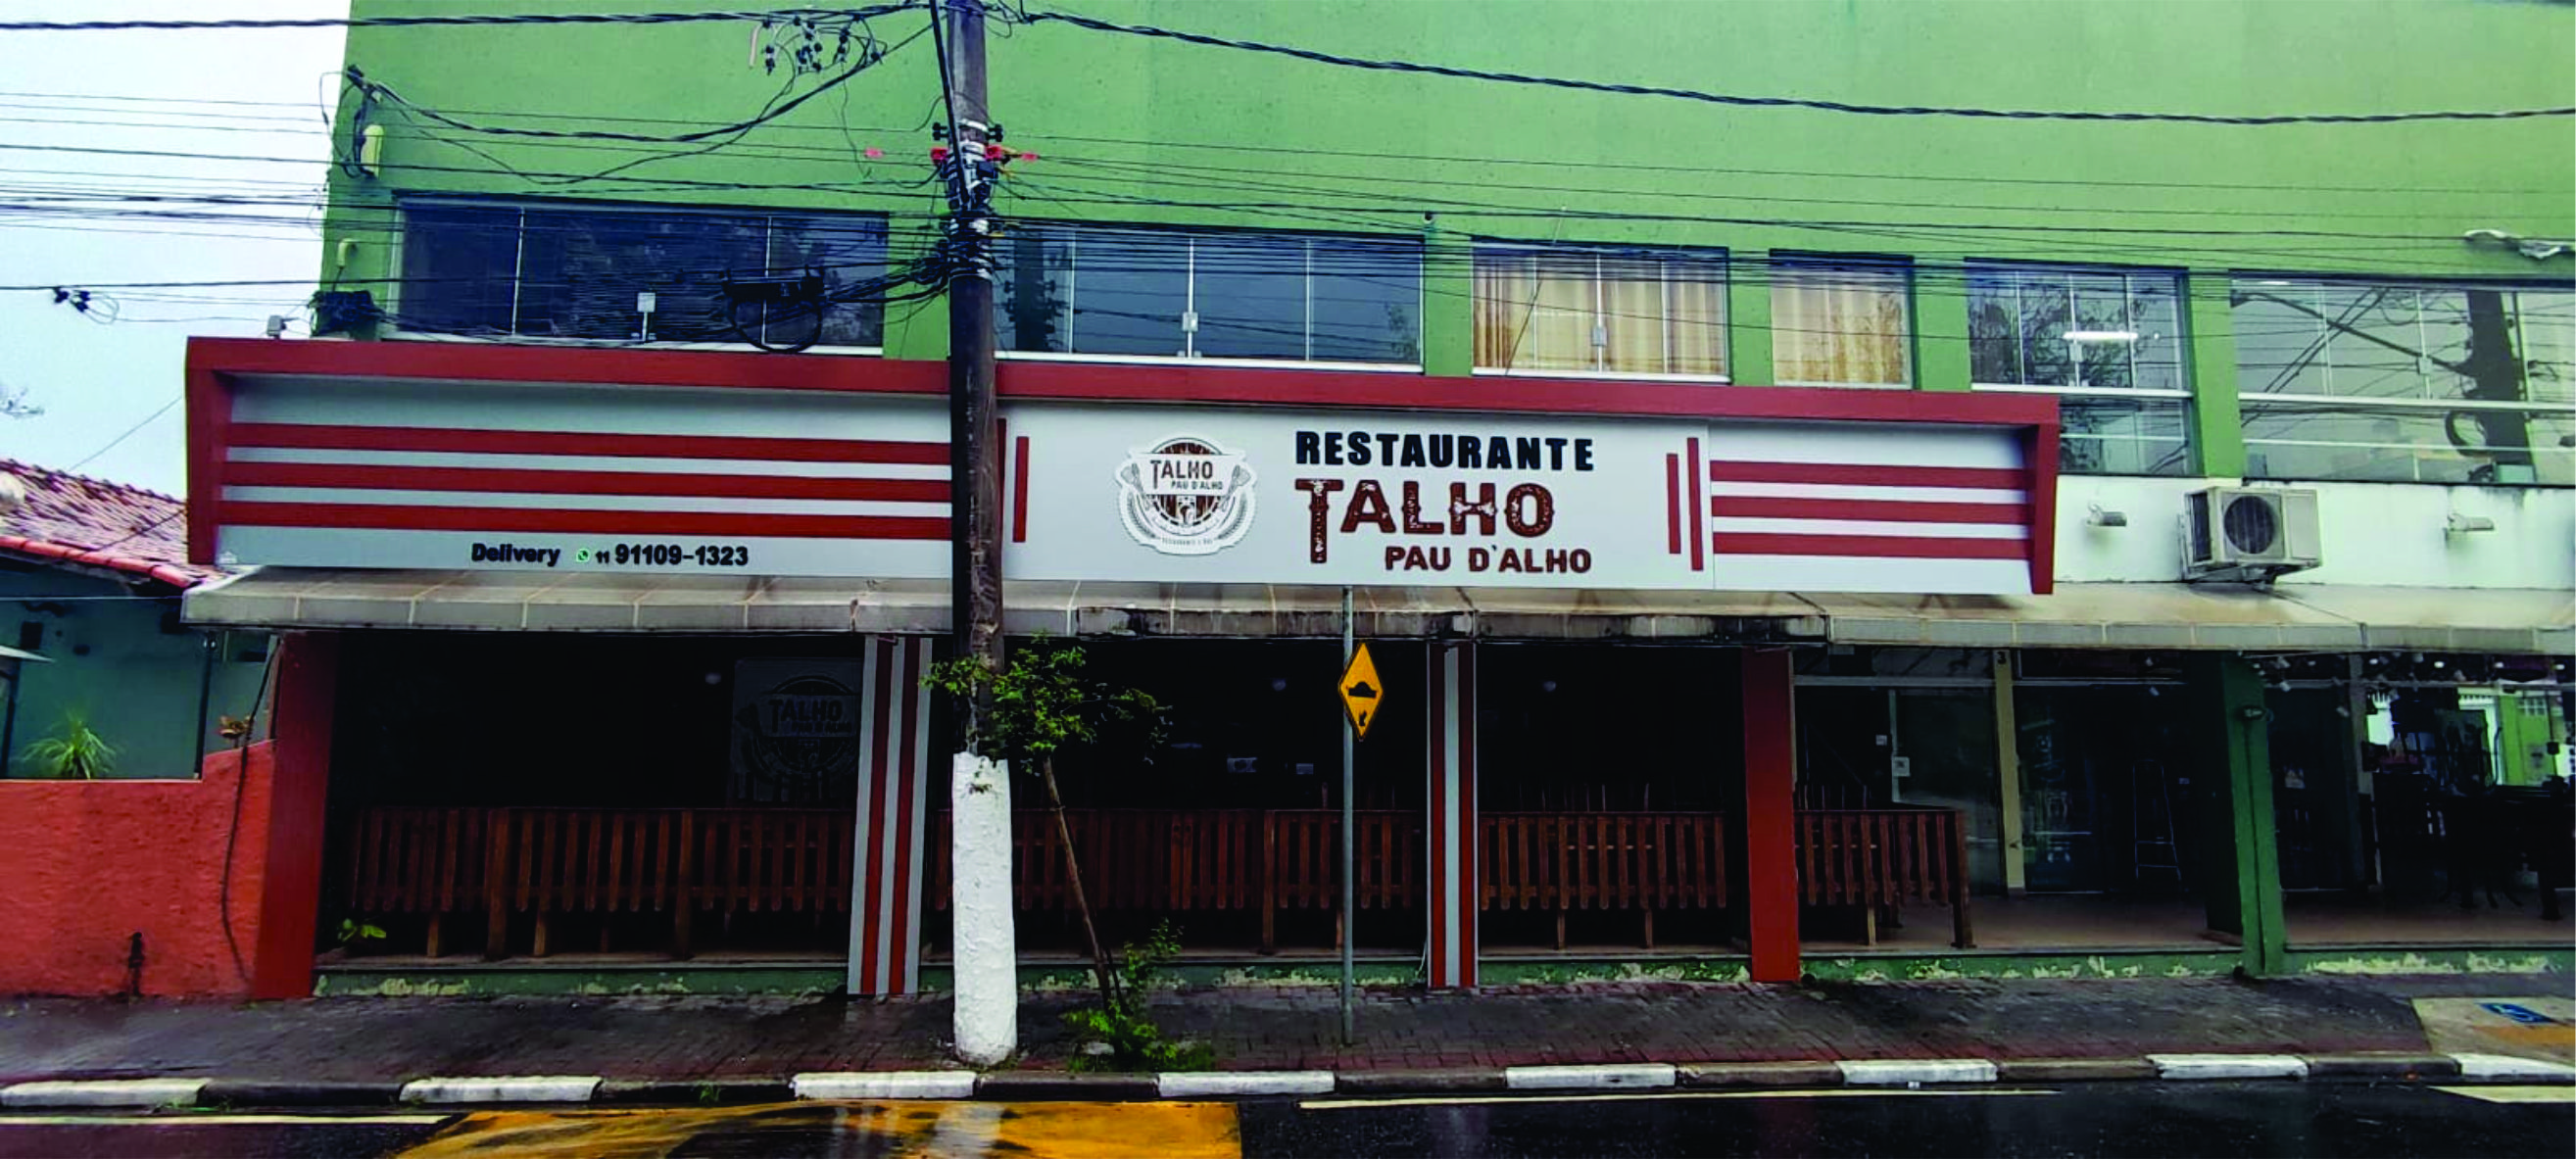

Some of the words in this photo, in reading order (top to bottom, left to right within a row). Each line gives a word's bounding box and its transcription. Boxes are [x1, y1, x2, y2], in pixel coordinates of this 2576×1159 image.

[1295, 430, 1594, 471] RESTAURANTE
[1150, 459, 1213, 489] TALHO
[1294, 478, 1555, 564] TALHO
[471, 542, 560, 567] Delivery
[595, 551, 610, 564] 11
[614, 543, 749, 566] 91109-1323
[1385, 545, 1451, 571] PAU
[1468, 544, 1592, 573] D'ALHO
[768, 699, 844, 733] TALHO
